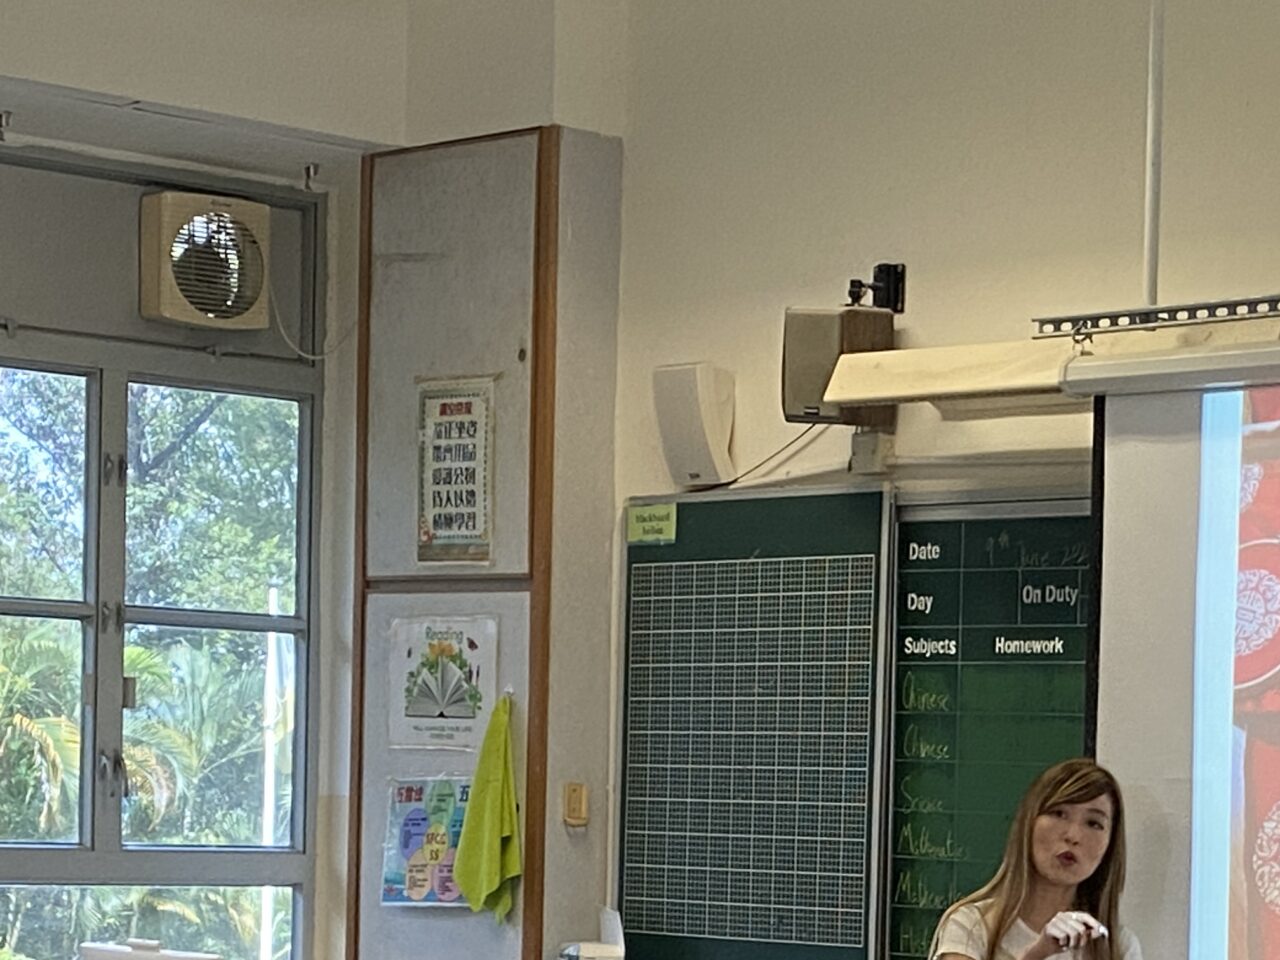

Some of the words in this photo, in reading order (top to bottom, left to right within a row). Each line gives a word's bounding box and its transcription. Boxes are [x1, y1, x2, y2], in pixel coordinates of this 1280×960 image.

[908, 542, 941, 561] Date
[907, 592, 934, 614] Day
[1022, 584, 1042, 604] On
[1045, 584, 1079, 607] Duty
[425, 626, 464, 645] Reading
[904, 636, 957, 657] Subjects
[994, 636, 1064, 654] Homework
[901, 670, 950, 711] Chinese
[902, 723, 950, 759] Chinese
